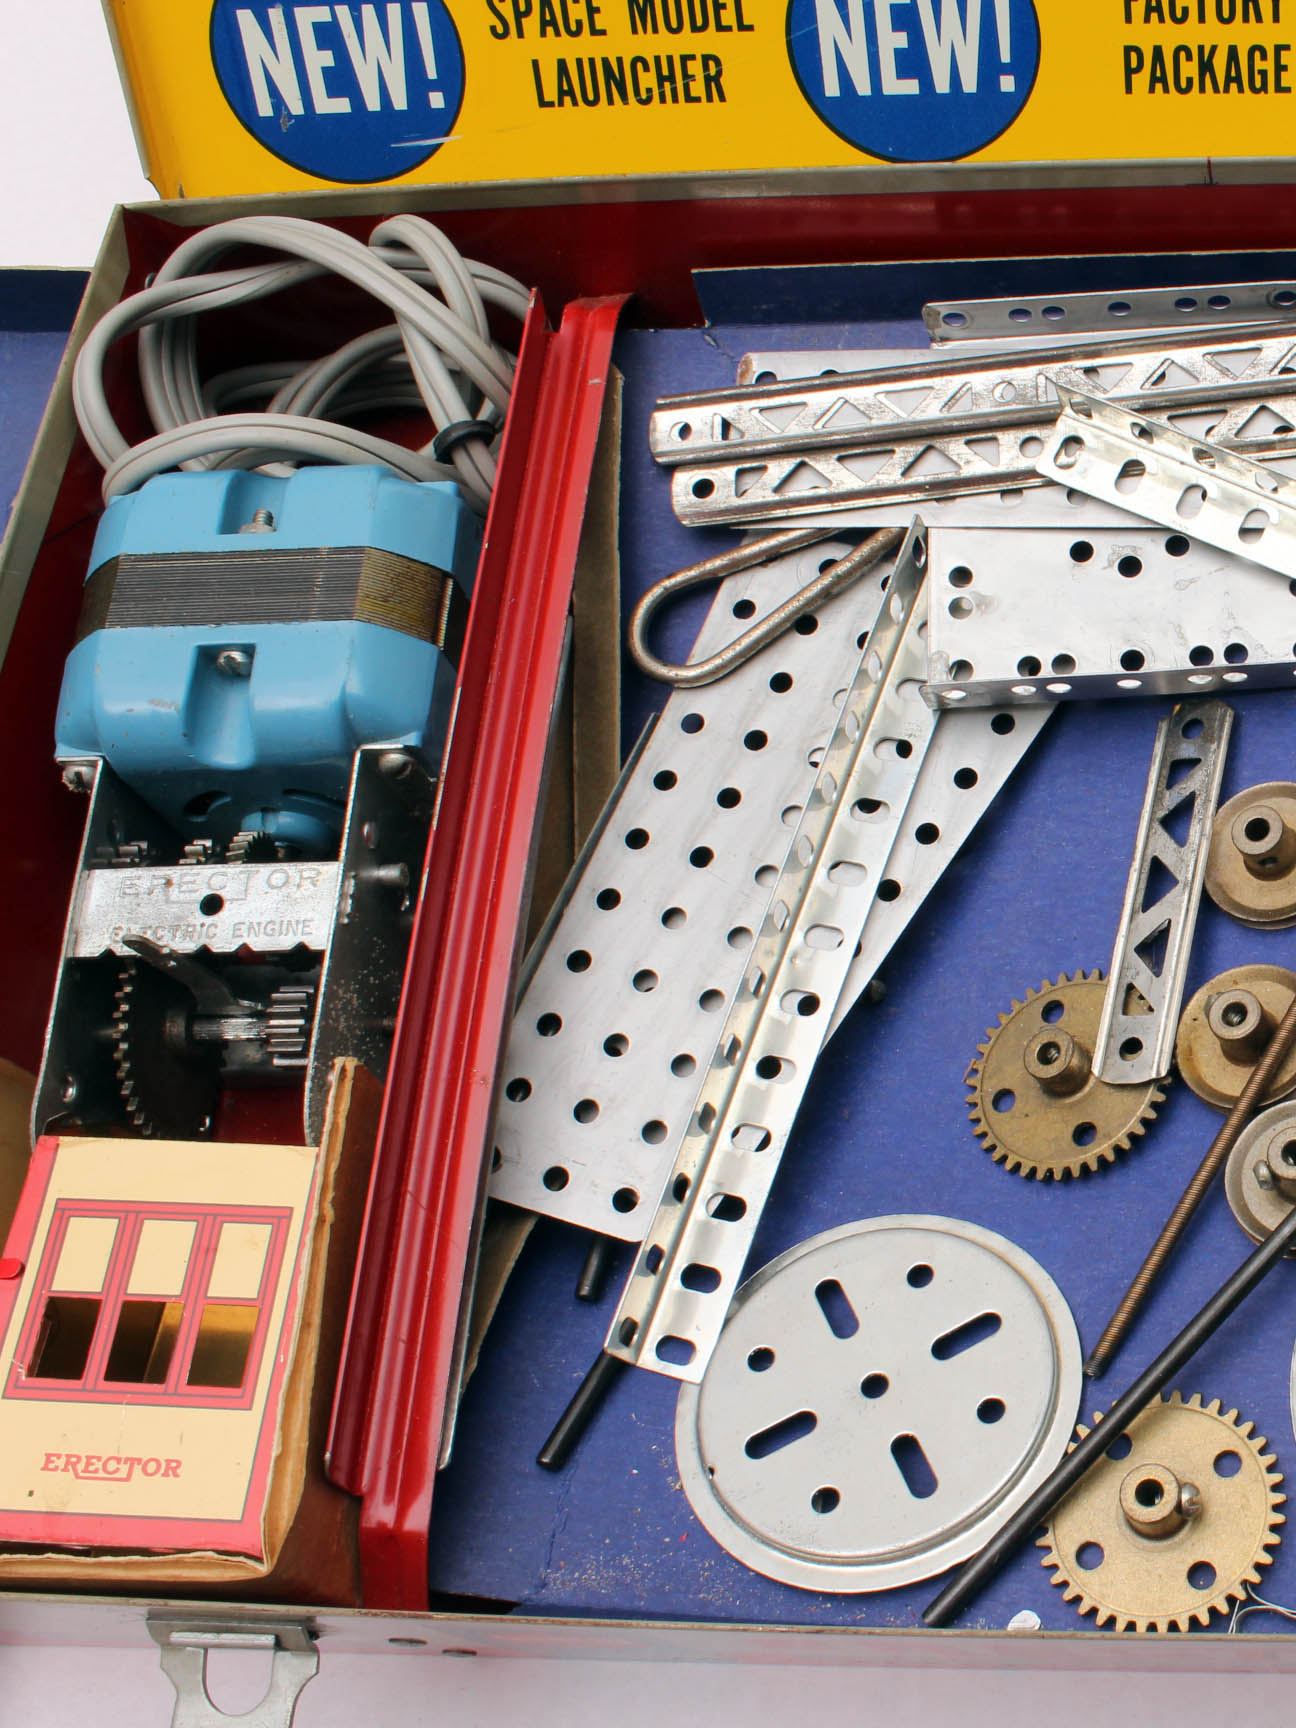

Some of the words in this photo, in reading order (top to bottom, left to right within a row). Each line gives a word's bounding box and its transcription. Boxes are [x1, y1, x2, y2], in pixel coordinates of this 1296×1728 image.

[487, 0, 608, 40] SPACE
[627, 0, 755, 36] MODEL
[235, 1, 446, 117] NEW!
[815, 0, 1016, 97] NEW!
[1123, 44, 1293, 95] PACKAGE
[531, 53, 727, 109] LAUNCHER
[116, 868, 322, 904] ERECTOR
[231, 919, 314, 940] ENGINE
[40, 1452, 183, 1483] ERECTOR
